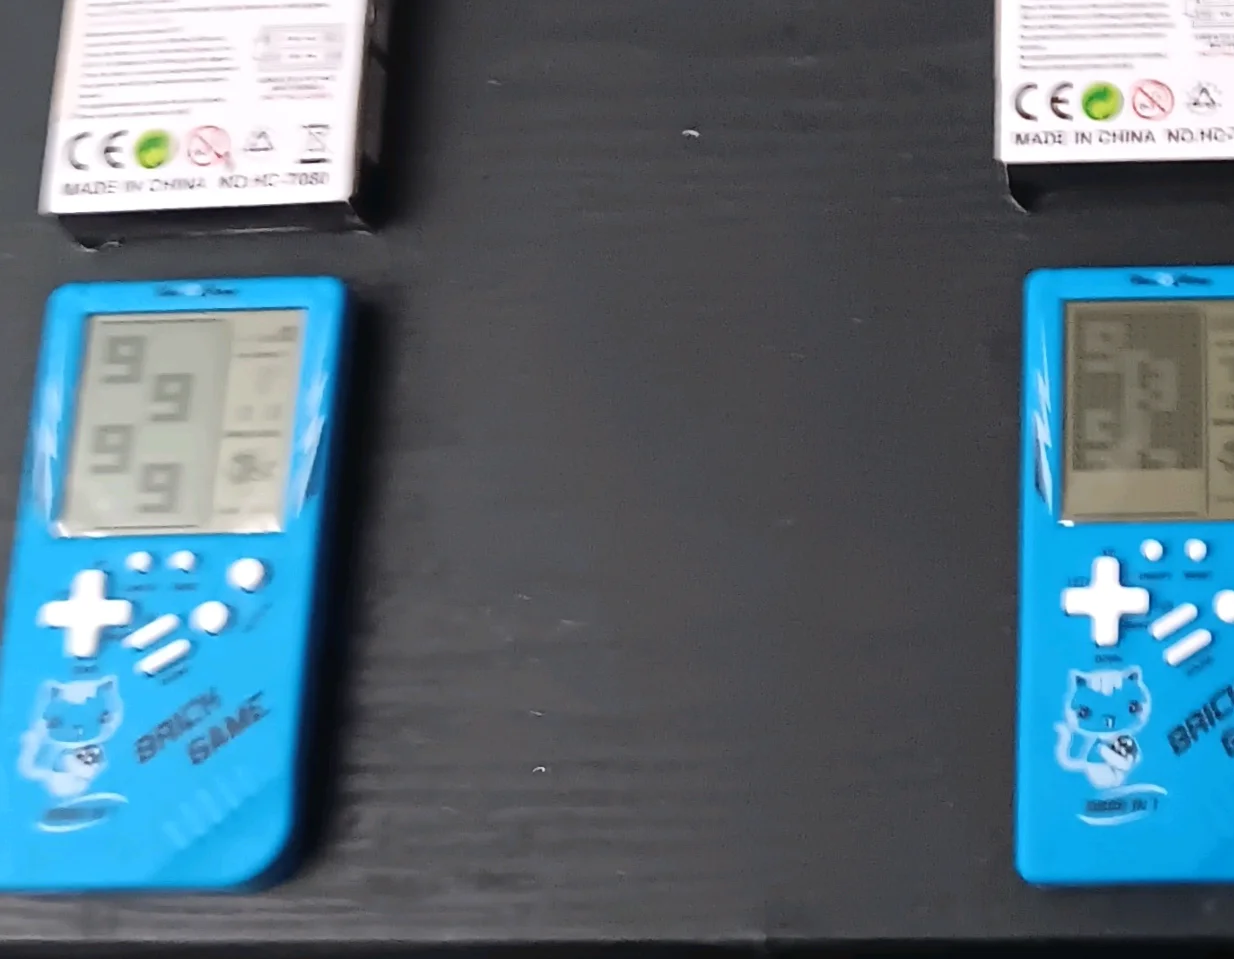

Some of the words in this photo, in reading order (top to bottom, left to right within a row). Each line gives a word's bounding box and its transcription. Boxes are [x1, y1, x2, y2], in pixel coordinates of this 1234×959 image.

[1014, 131, 1069, 146] MADE
[1074, 130, 1093, 145] IN
[1097, 129, 1156, 144] CHINA
[61, 181, 118, 196] MADE
